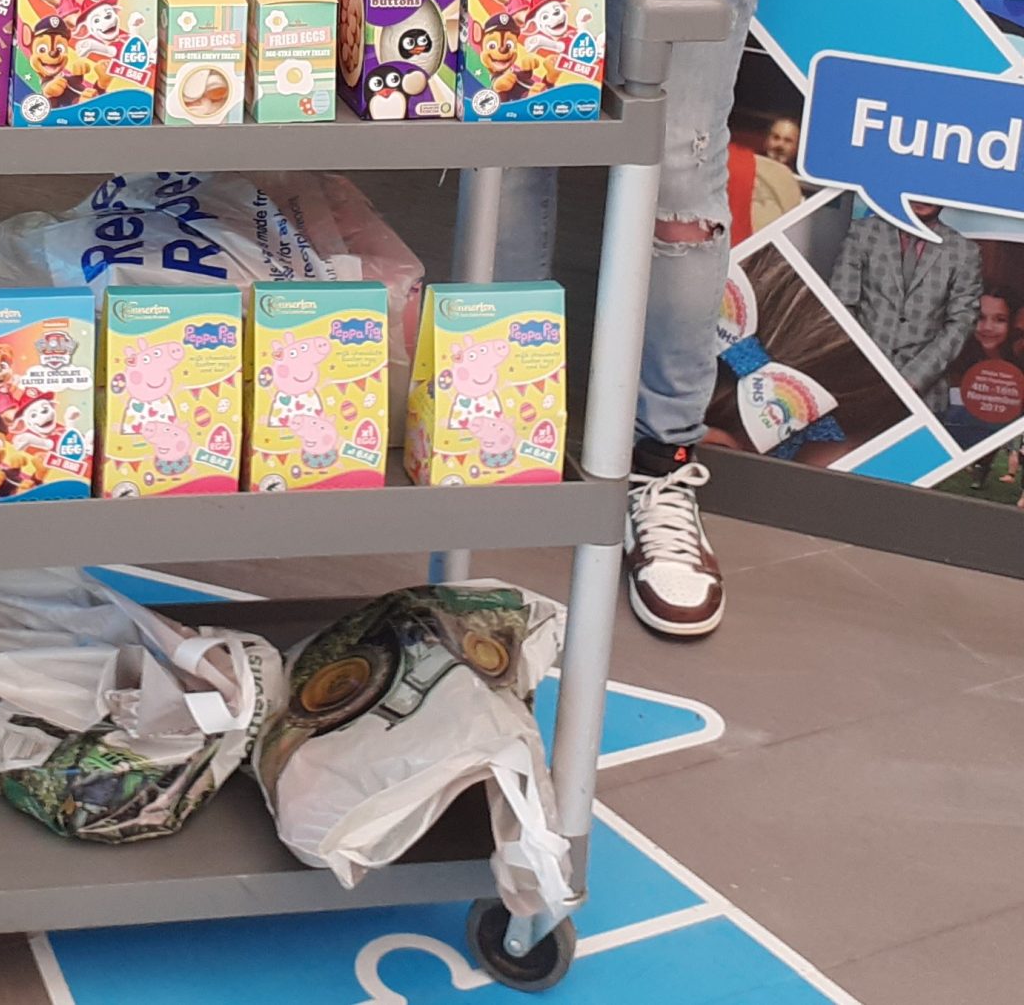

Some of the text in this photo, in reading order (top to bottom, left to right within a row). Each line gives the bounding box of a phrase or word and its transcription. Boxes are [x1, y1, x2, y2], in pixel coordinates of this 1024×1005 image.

[130, 40, 142, 53] x1
[178, 33, 237, 49] FRIED EGGS
[268, 30, 326, 48] FRIED EGGS
[579, 36, 590, 49] x1
[124, 52, 147, 64] EGG
[572, 47, 595, 59] EGG
[125, 68, 143, 82] BAR
[574, 63, 591, 77] BAR
[850, 97, 1023, 172] Fund
[184, 325, 236, 347] Peppa Pig
[330, 320, 383, 342] Peppa Pig
[509, 321, 560, 345] Peppa Pig
[716, 324, 738, 345] NHS
[752, 377, 764, 403] NHS
[980, 402, 1007, 413] 2019
[60, 444, 84, 456] EGG
